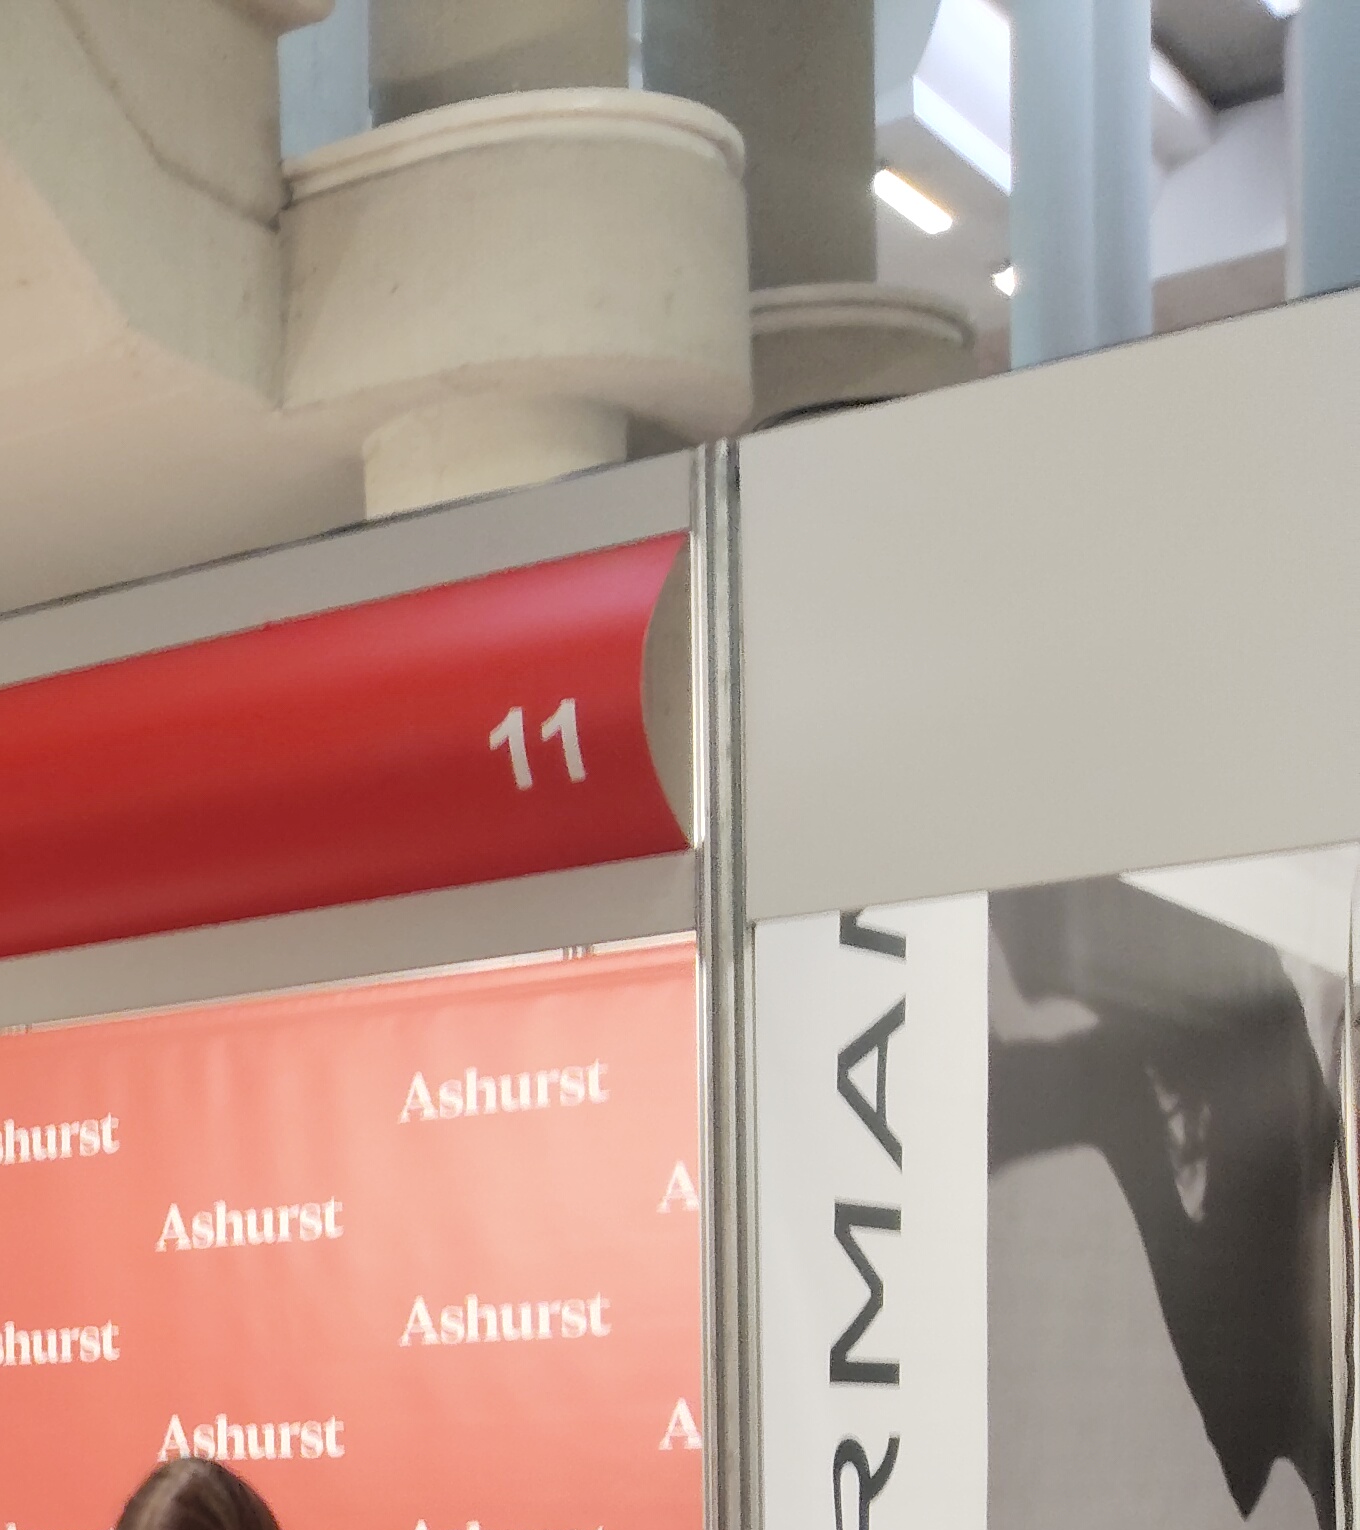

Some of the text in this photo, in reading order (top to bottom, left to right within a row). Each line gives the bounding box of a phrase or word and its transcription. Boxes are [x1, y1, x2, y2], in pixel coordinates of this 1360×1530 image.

[489, 698, 587, 790] 11
[397, 1058, 611, 1124] Ashurst
[155, 1196, 344, 1252] Ashurst
[398, 1292, 612, 1347] Ashurst
[157, 1413, 345, 1461] Ashurst
